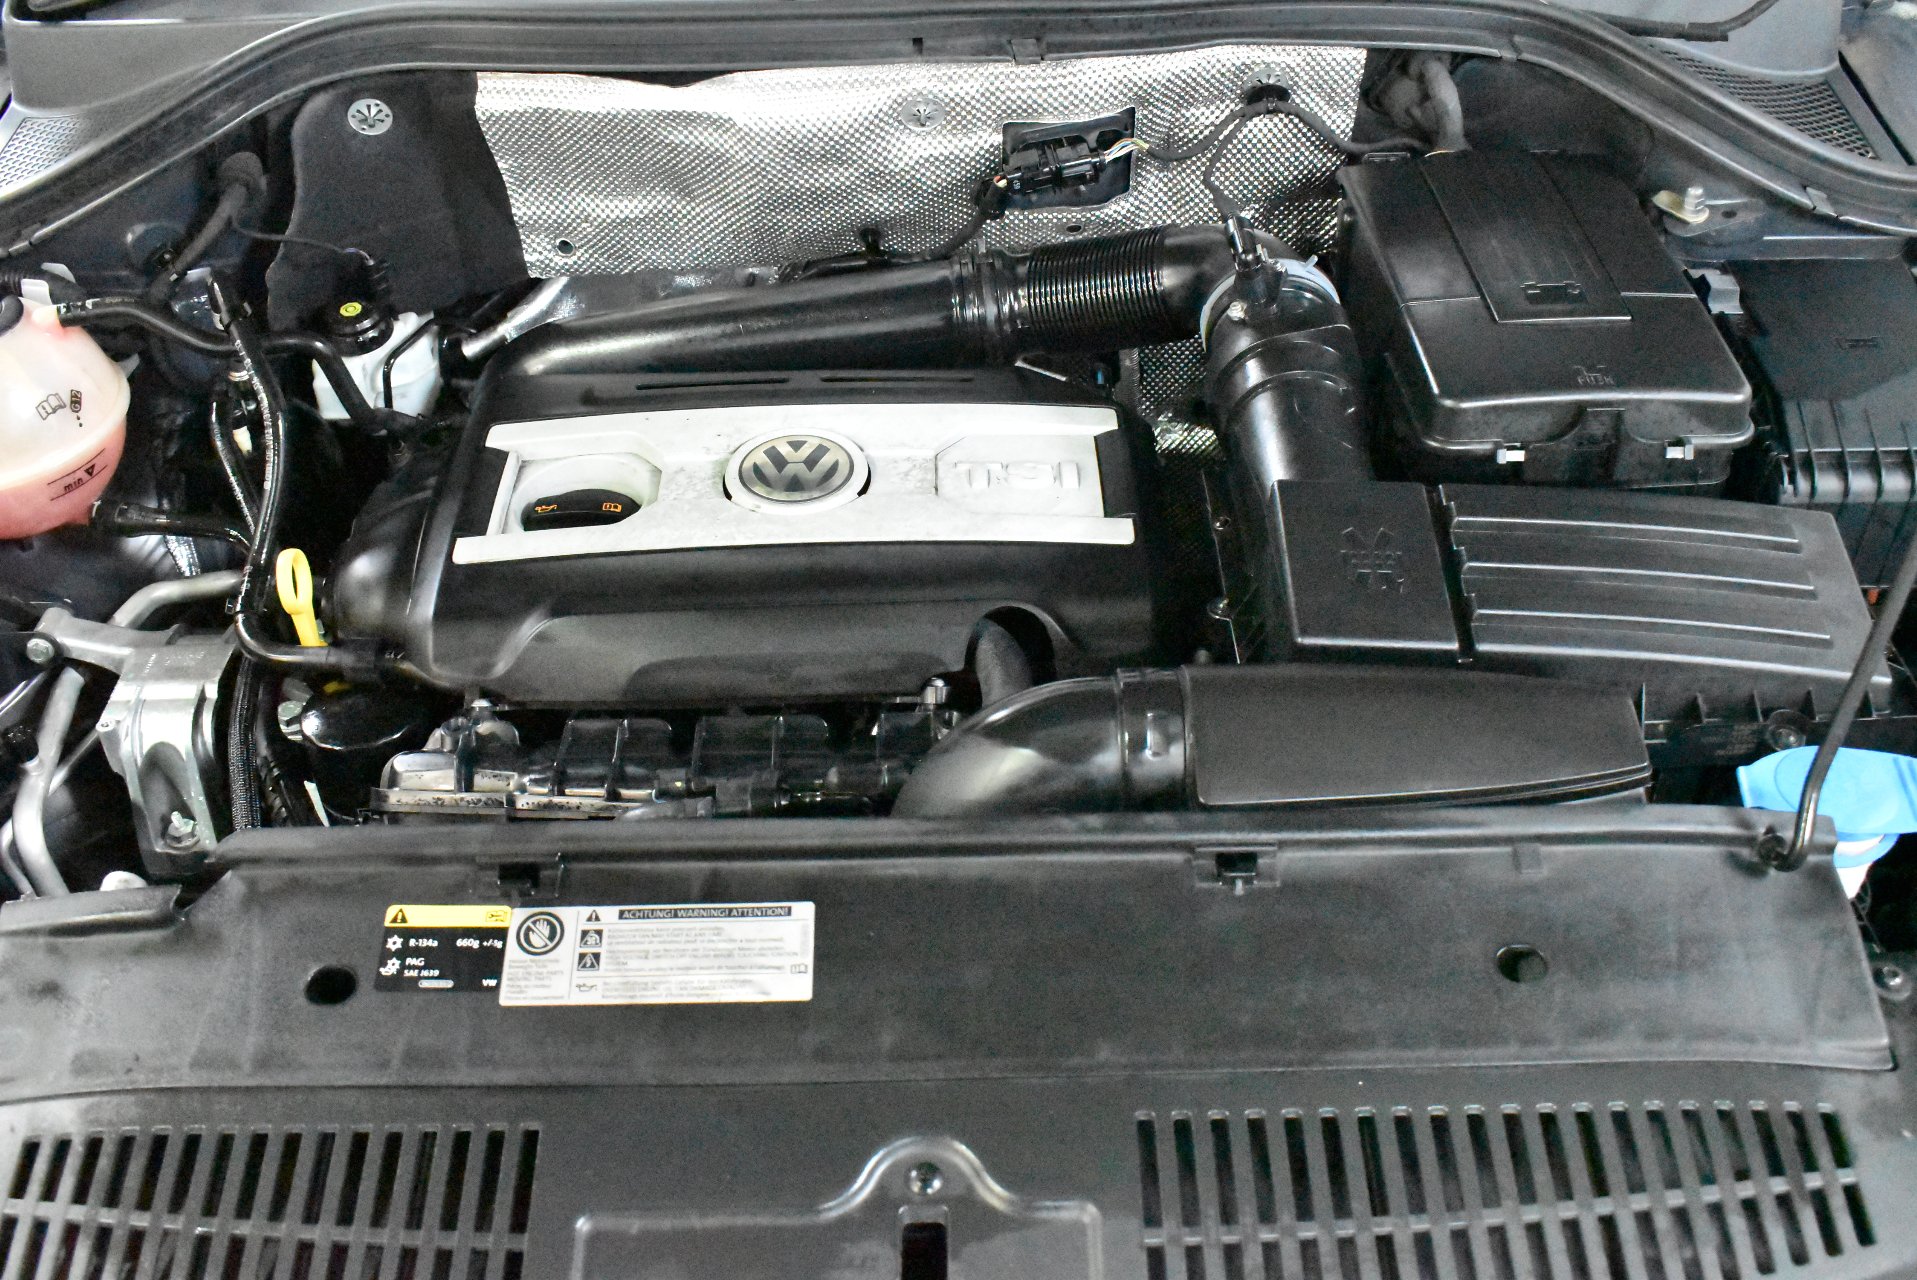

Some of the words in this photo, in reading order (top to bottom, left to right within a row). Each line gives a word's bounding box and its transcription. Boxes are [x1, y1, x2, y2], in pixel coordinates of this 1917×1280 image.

[738, 434, 854, 502] VW
[954, 460, 1081, 490] TSI
[63, 477, 84, 493] min
[621, 909, 674, 919] ACHTUNG!
[677, 908, 729, 918] WARNING!
[730, 906, 789, 917] ATTENTION!
[409, 938, 438, 947] R-134a
[456, 938, 480, 949] 660g
[405, 957, 425, 966] PAG
[404, 969, 419, 977] SAE
[420, 969, 439, 977] J639
[482, 979, 498, 987] VW
